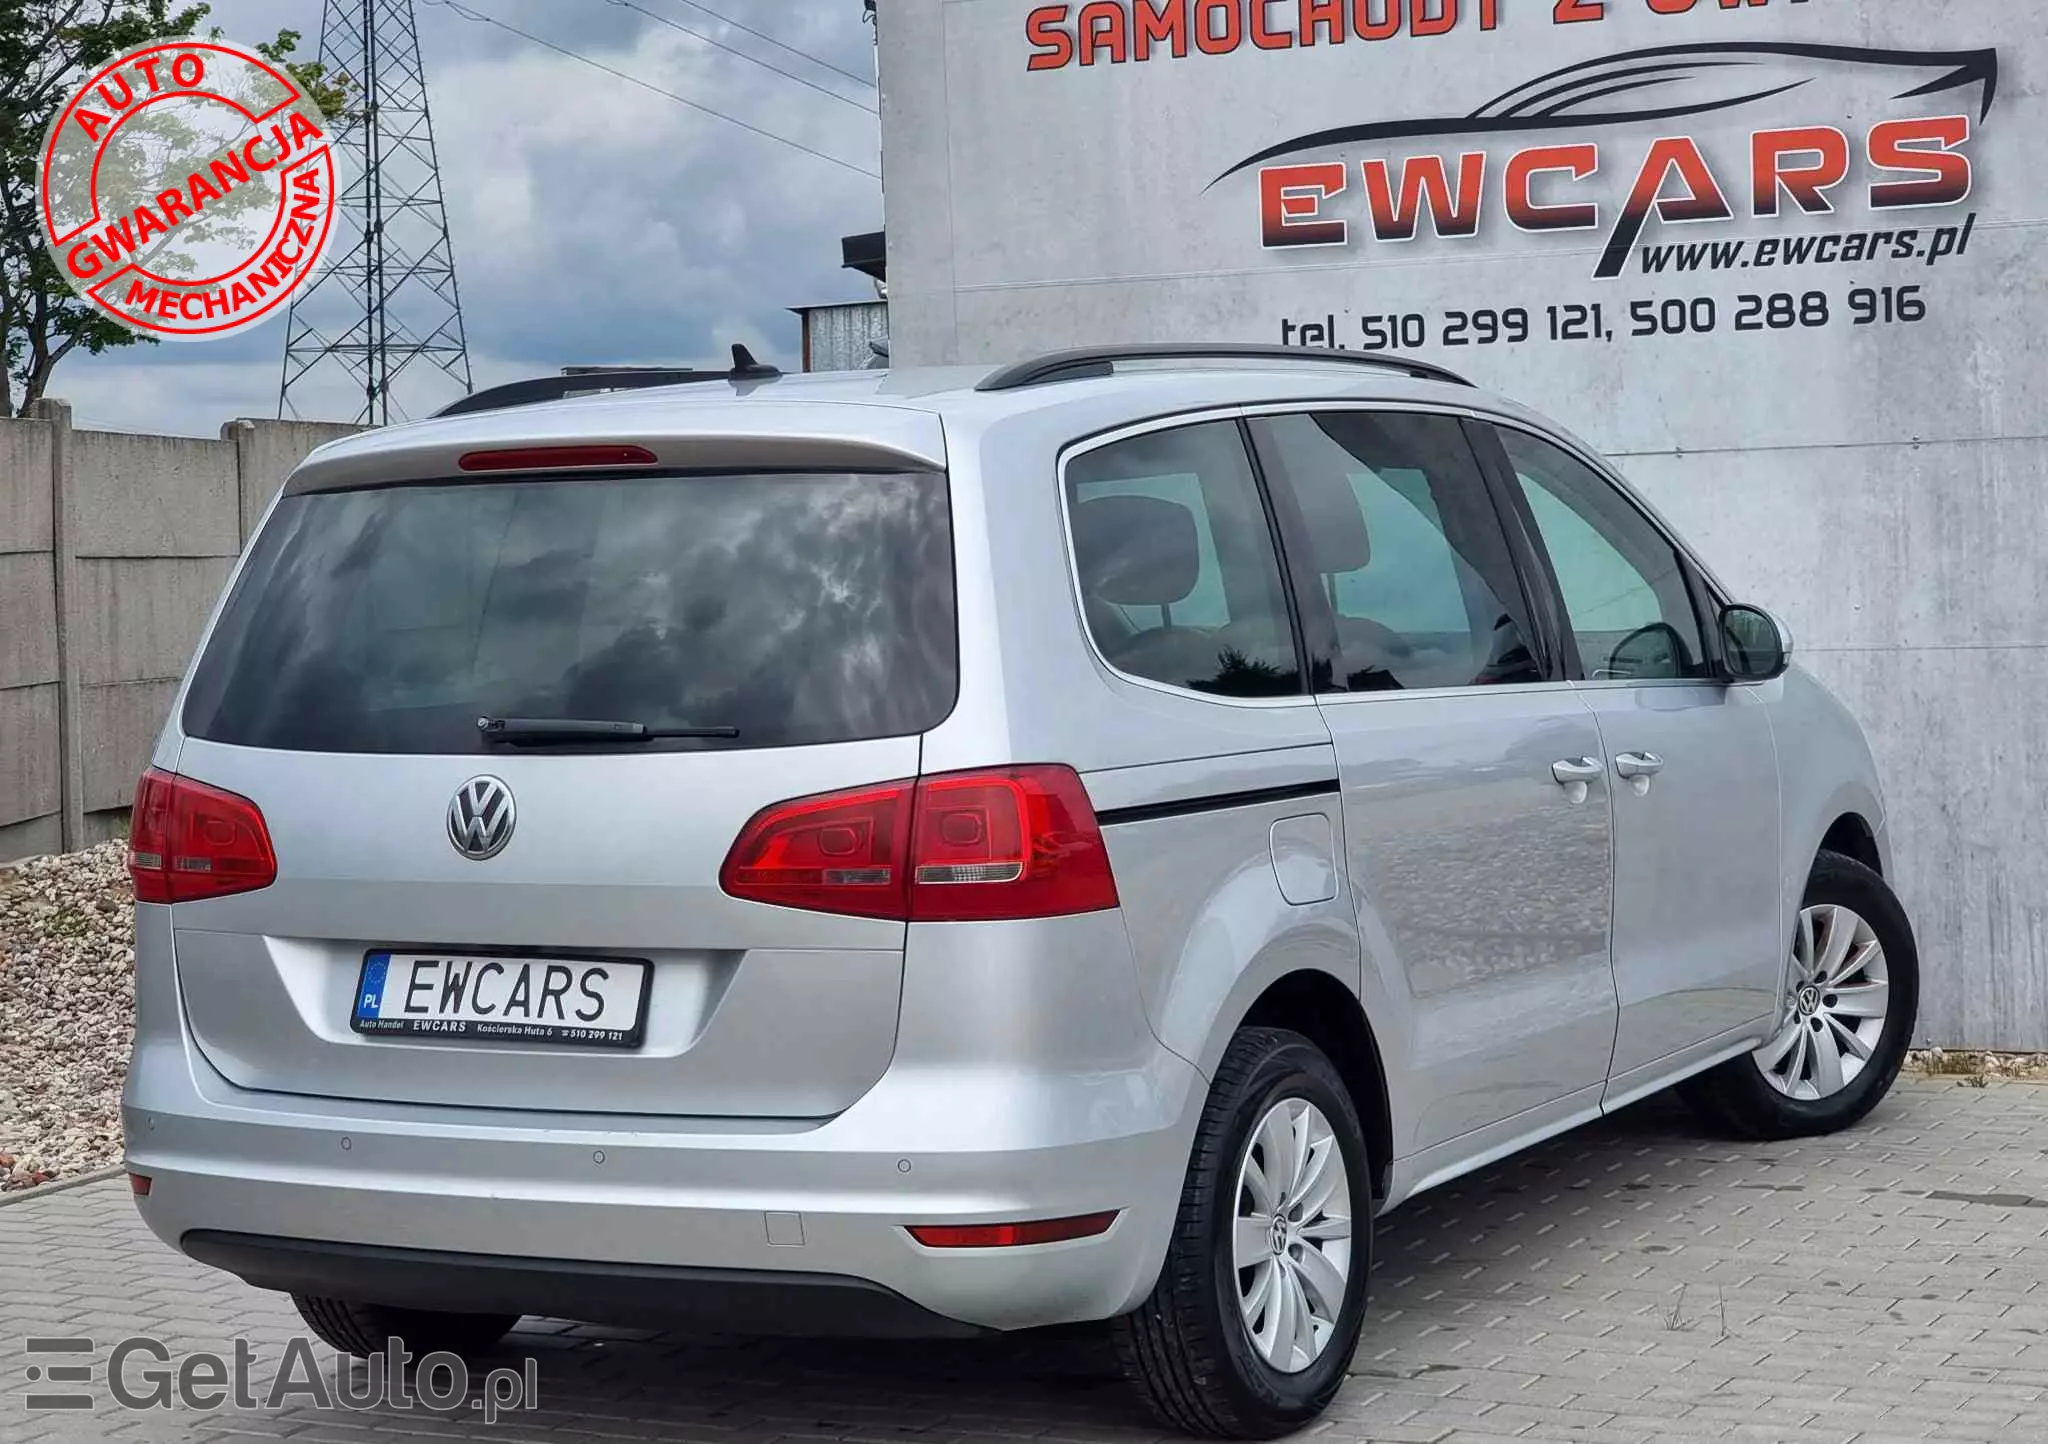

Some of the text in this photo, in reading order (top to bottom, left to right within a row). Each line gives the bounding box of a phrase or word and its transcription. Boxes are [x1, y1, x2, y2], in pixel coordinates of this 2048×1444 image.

[1259, 115, 1972, 280] EWCARS
[1641, 212, 1977, 274] www.ewcars.pl
[1281, 285, 1926, 350] tel. 510 299 121, 500 288 916
[363, 993, 379, 1009] PL
[404, 960, 610, 1022] EWCARS
[360, 1020, 376, 1029] Auto
[377, 1020, 404, 1030] Handel
[413, 1020, 466, 1032] EWCARS
[477, 1023, 522, 1035] Kościerska
[524, 1026, 545, 1036] Huta
[547, 1027, 553, 1037] 6
[570, 1029, 586, 1038] 510
[588, 1031, 605, 1040] 299
